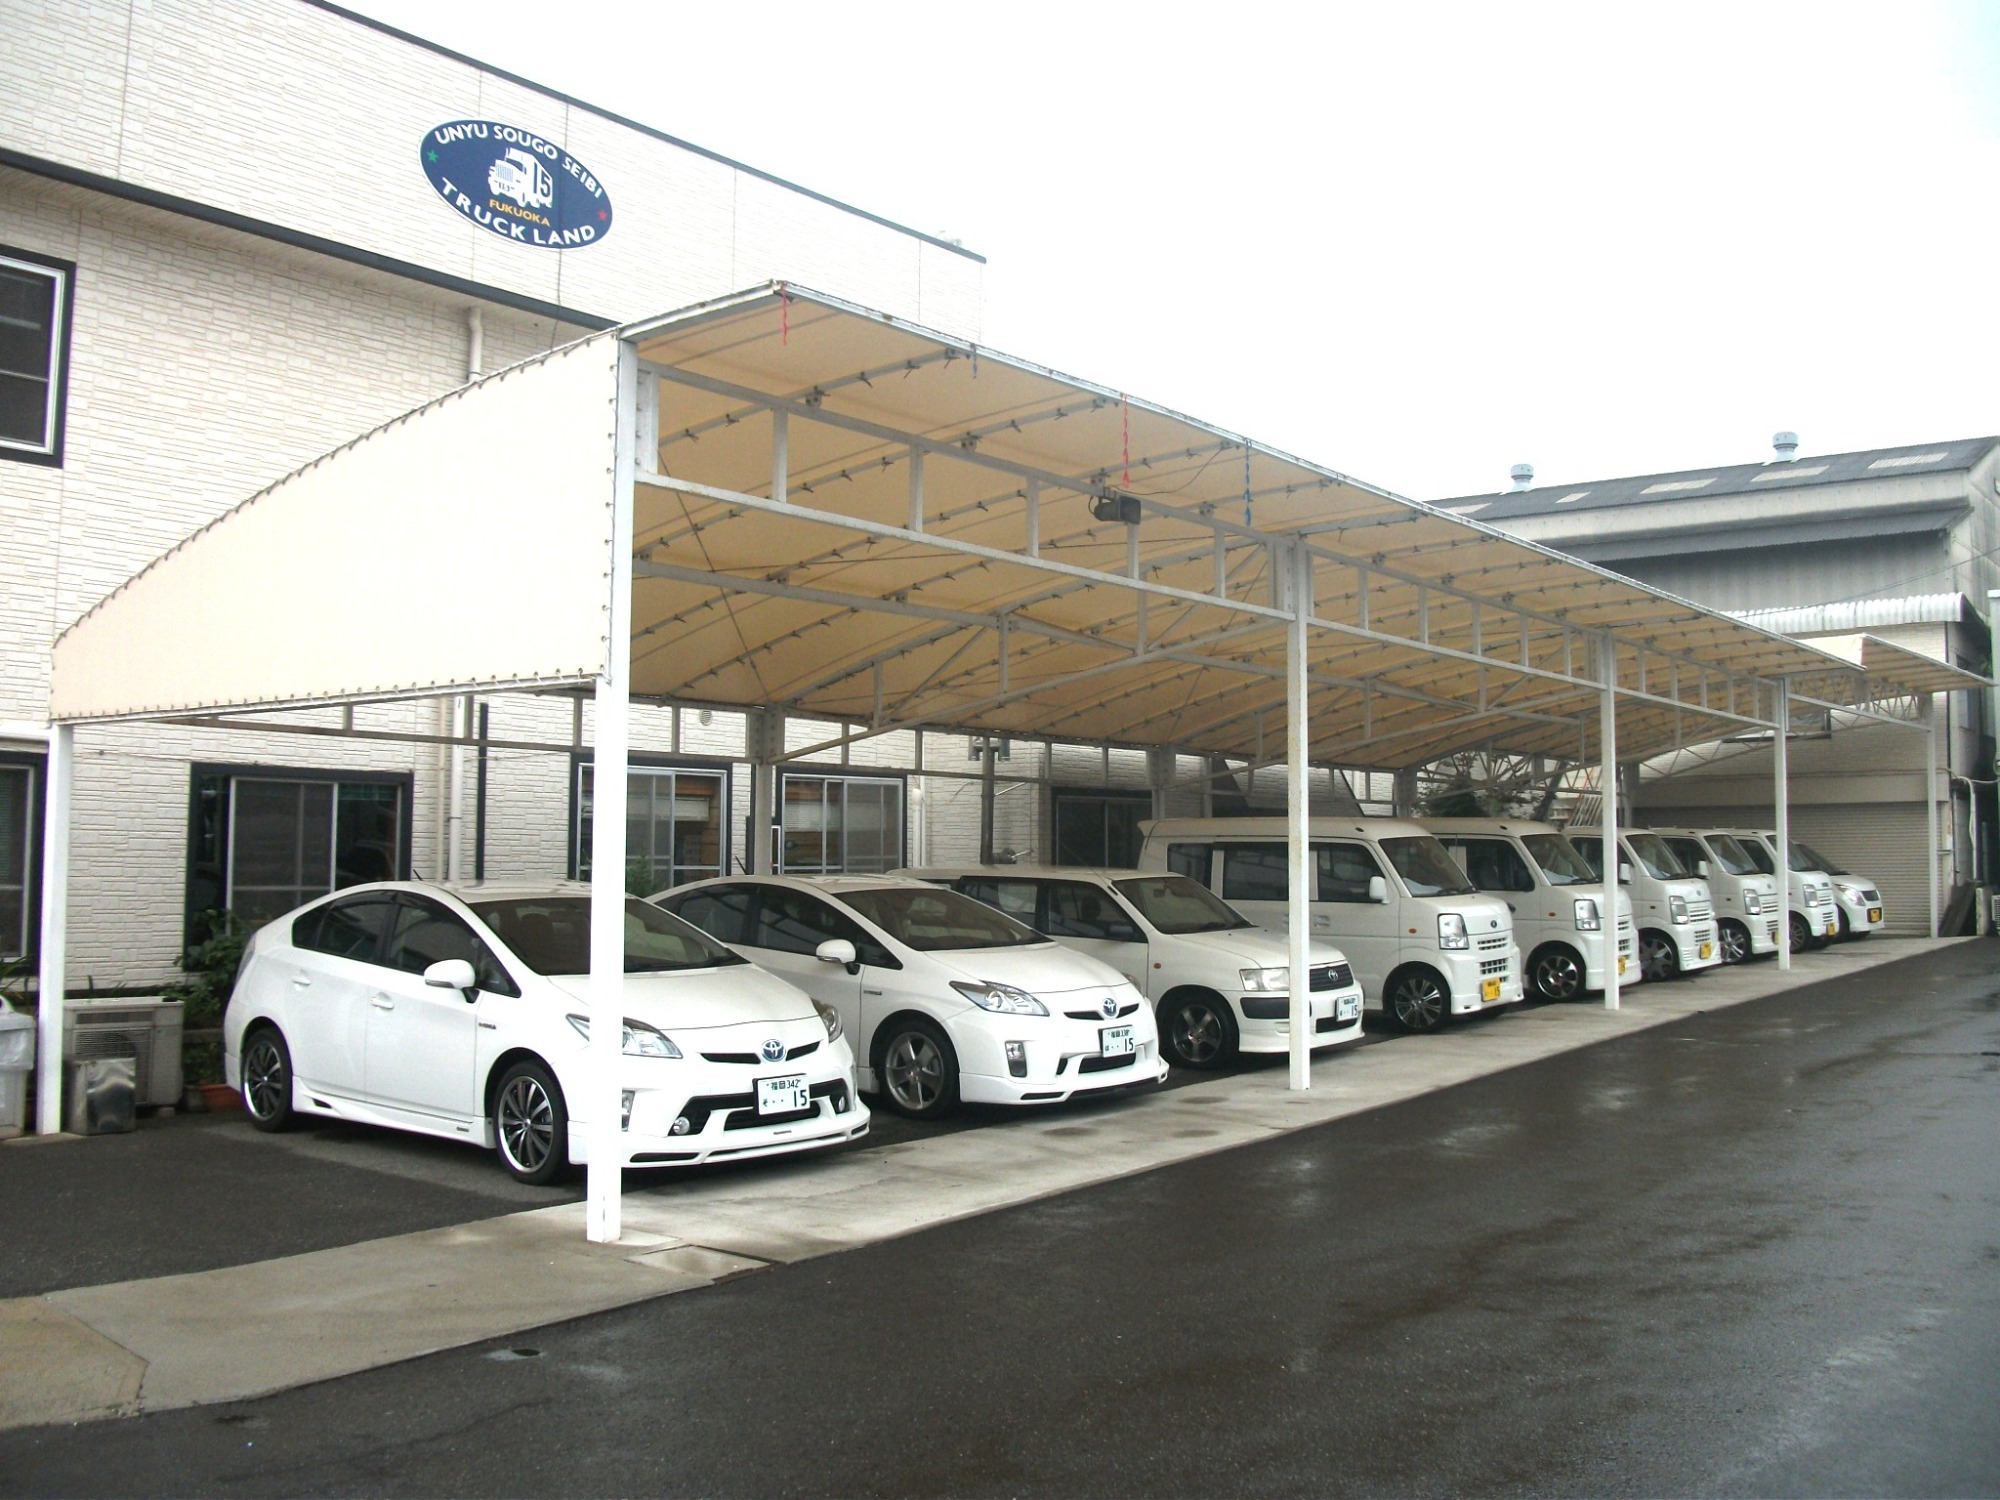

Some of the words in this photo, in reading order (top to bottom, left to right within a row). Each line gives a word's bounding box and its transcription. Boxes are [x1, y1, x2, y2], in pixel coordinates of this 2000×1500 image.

[434, 123, 488, 145] UNYU
[493, 125, 559, 160] SOUGO
[561, 156, 603, 199] SEIBI
[533, 160, 552, 197] 15
[440, 176, 526, 241] TRUCK
[532, 224, 596, 246] LAND
[488, 198, 551, 227] FUKUOKA
[1351, 1004, 1358, 1017] 15
[1124, 1037, 1134, 1052] 15
[793, 1089, 808, 1108] 15
